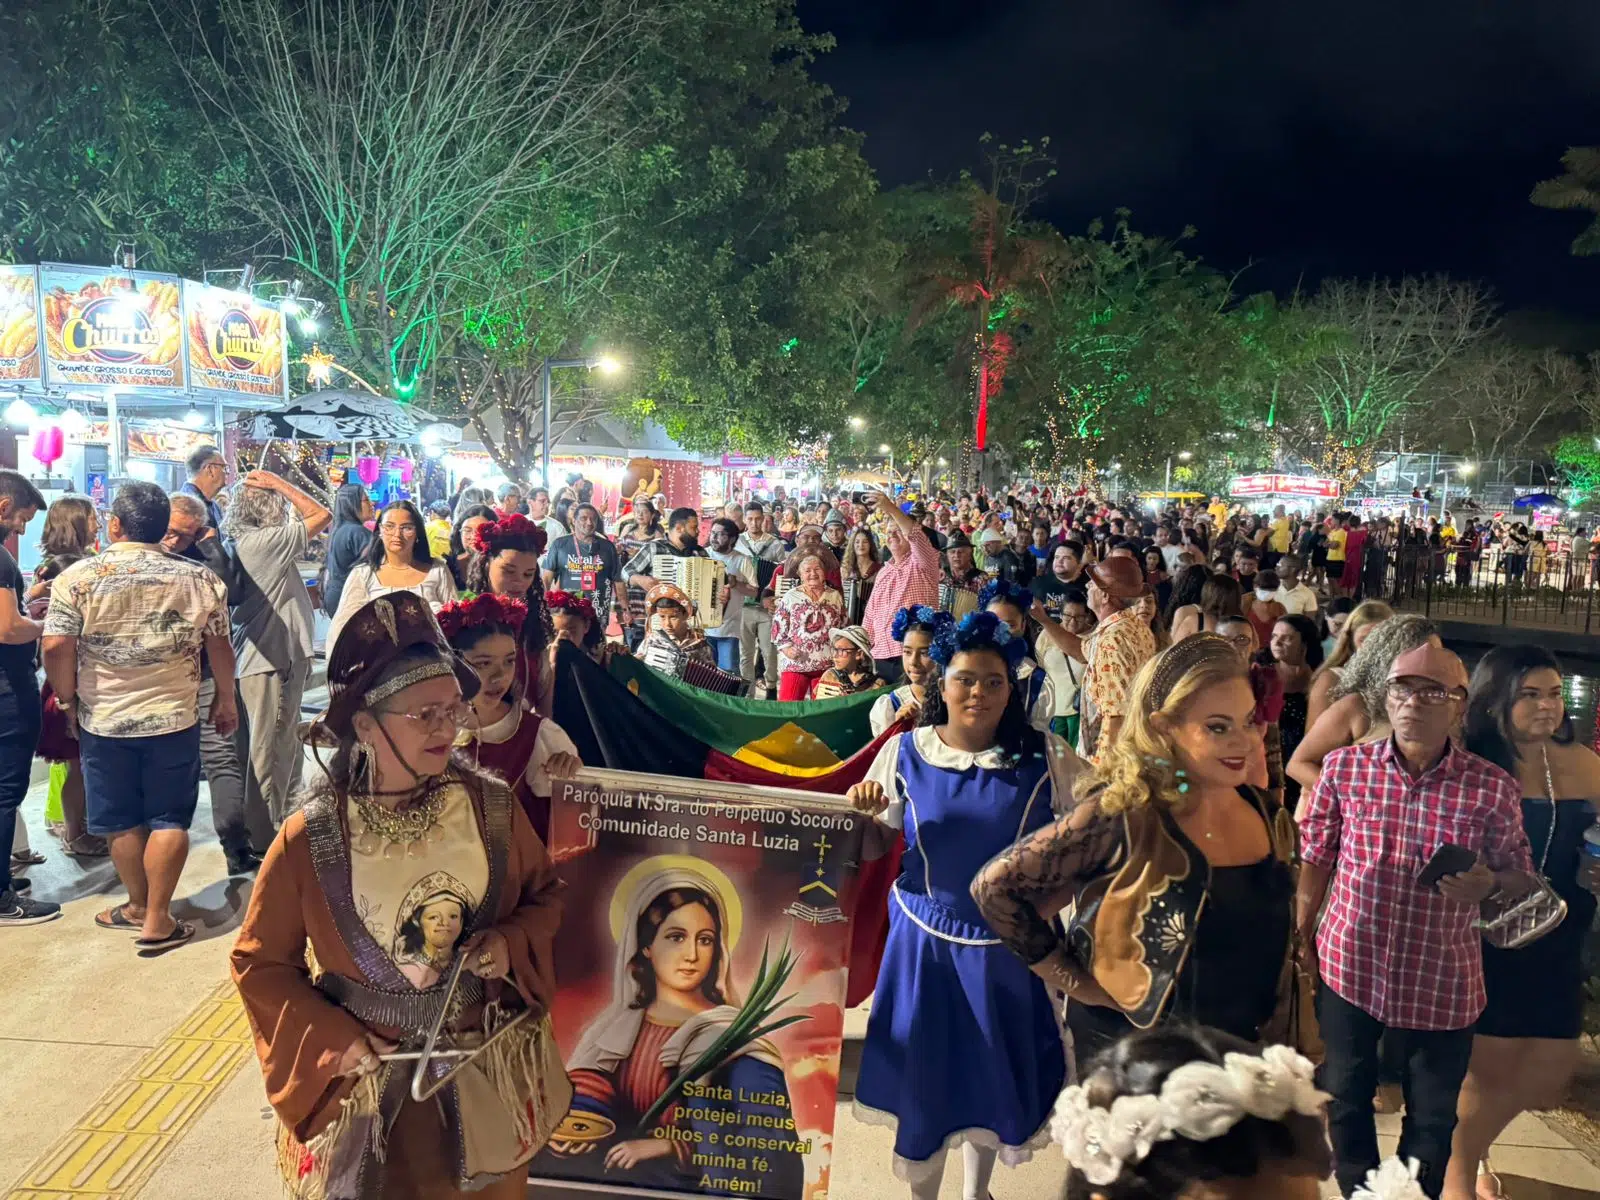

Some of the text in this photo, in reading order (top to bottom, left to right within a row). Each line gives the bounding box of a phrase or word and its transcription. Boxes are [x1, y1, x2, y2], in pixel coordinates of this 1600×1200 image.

[94, 365, 127, 374] GROSSO
[135, 367, 173, 377] GOSTOSO
[563, 784, 632, 810] Paróquia
[690, 798, 709, 816] do
[790, 809, 854, 832] Socorro
[578, 812, 799, 851] Comunidade Santa Luzia
[682, 1081, 790, 1109] Santa Luzia,
[674, 1106, 795, 1130] protejei meus
[654, 1125, 812, 1155] olhos e conservai
[692, 1152, 773, 1173] minha fé.
[699, 1173, 762, 1194] Amém!
